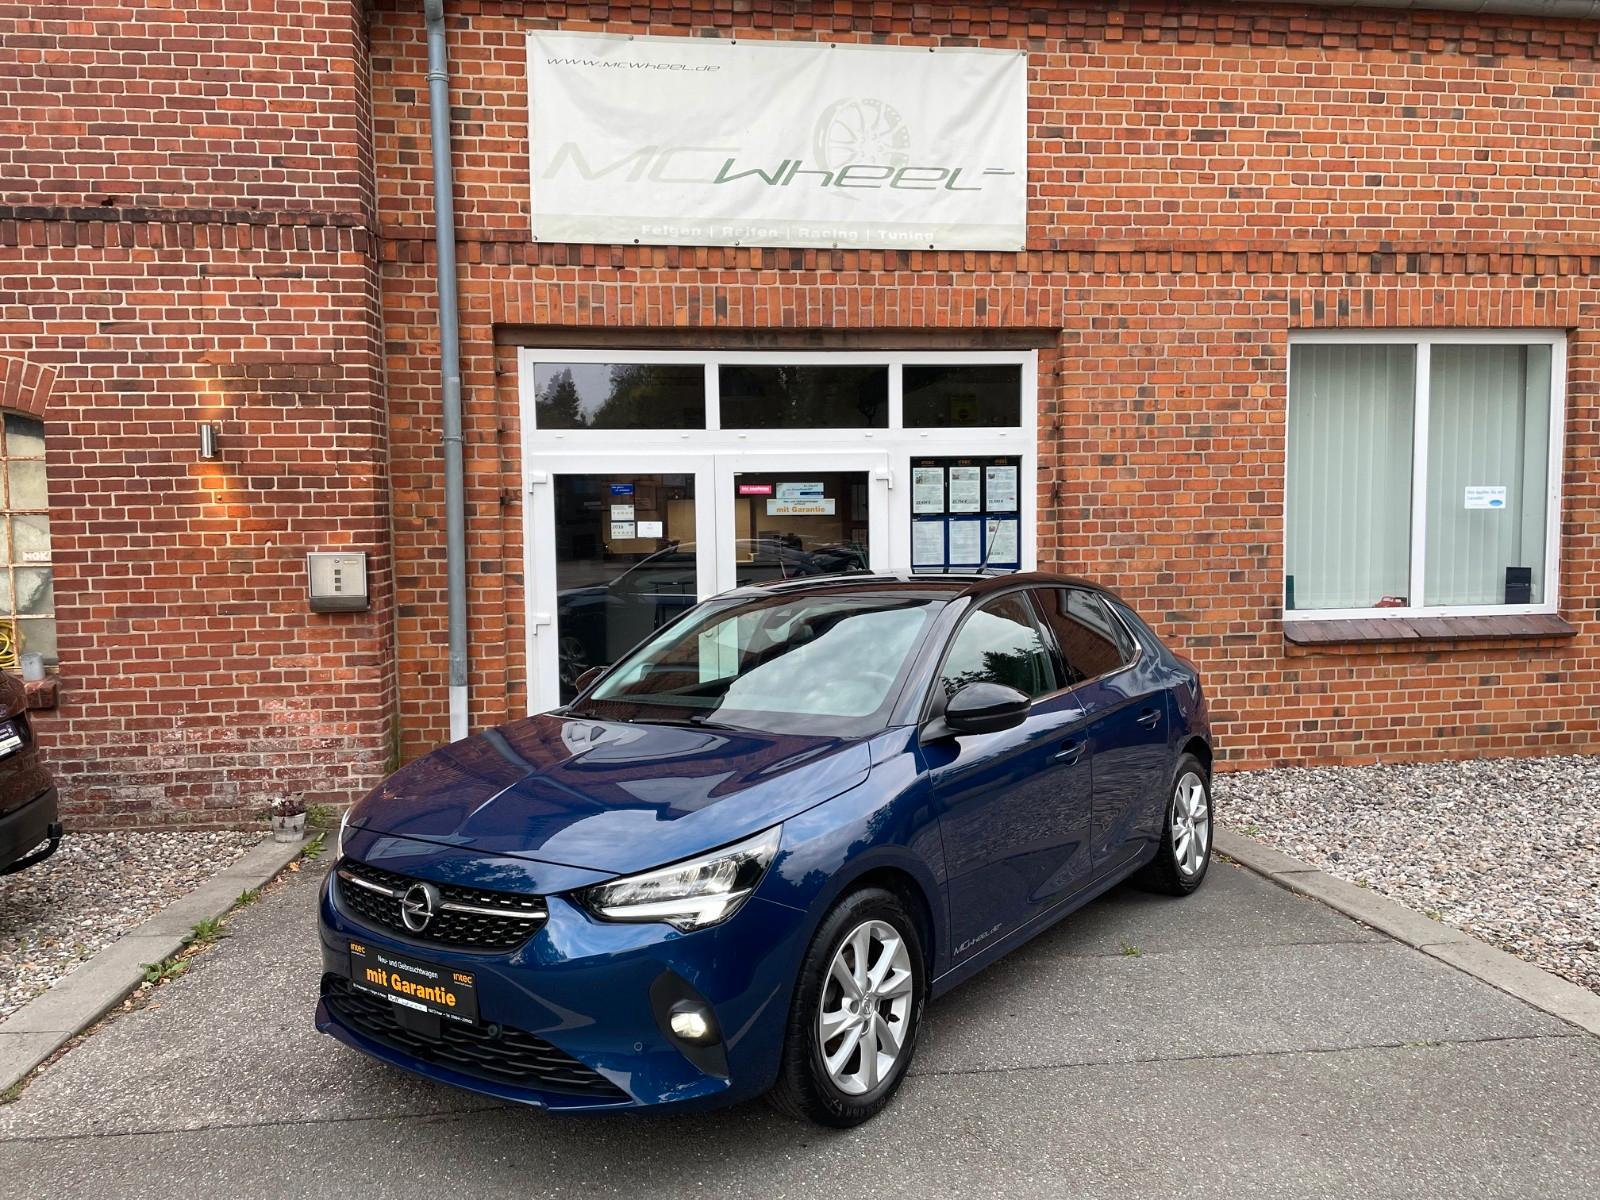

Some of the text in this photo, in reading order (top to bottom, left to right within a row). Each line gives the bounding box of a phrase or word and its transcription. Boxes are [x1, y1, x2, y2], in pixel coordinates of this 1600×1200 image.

[641, 225, 935, 242] Felgen Reifen Racing Tuning
[377, 954, 389, 965] Neu-
[366, 967, 388, 987] mit
[390, 972, 457, 1008] Garantie
